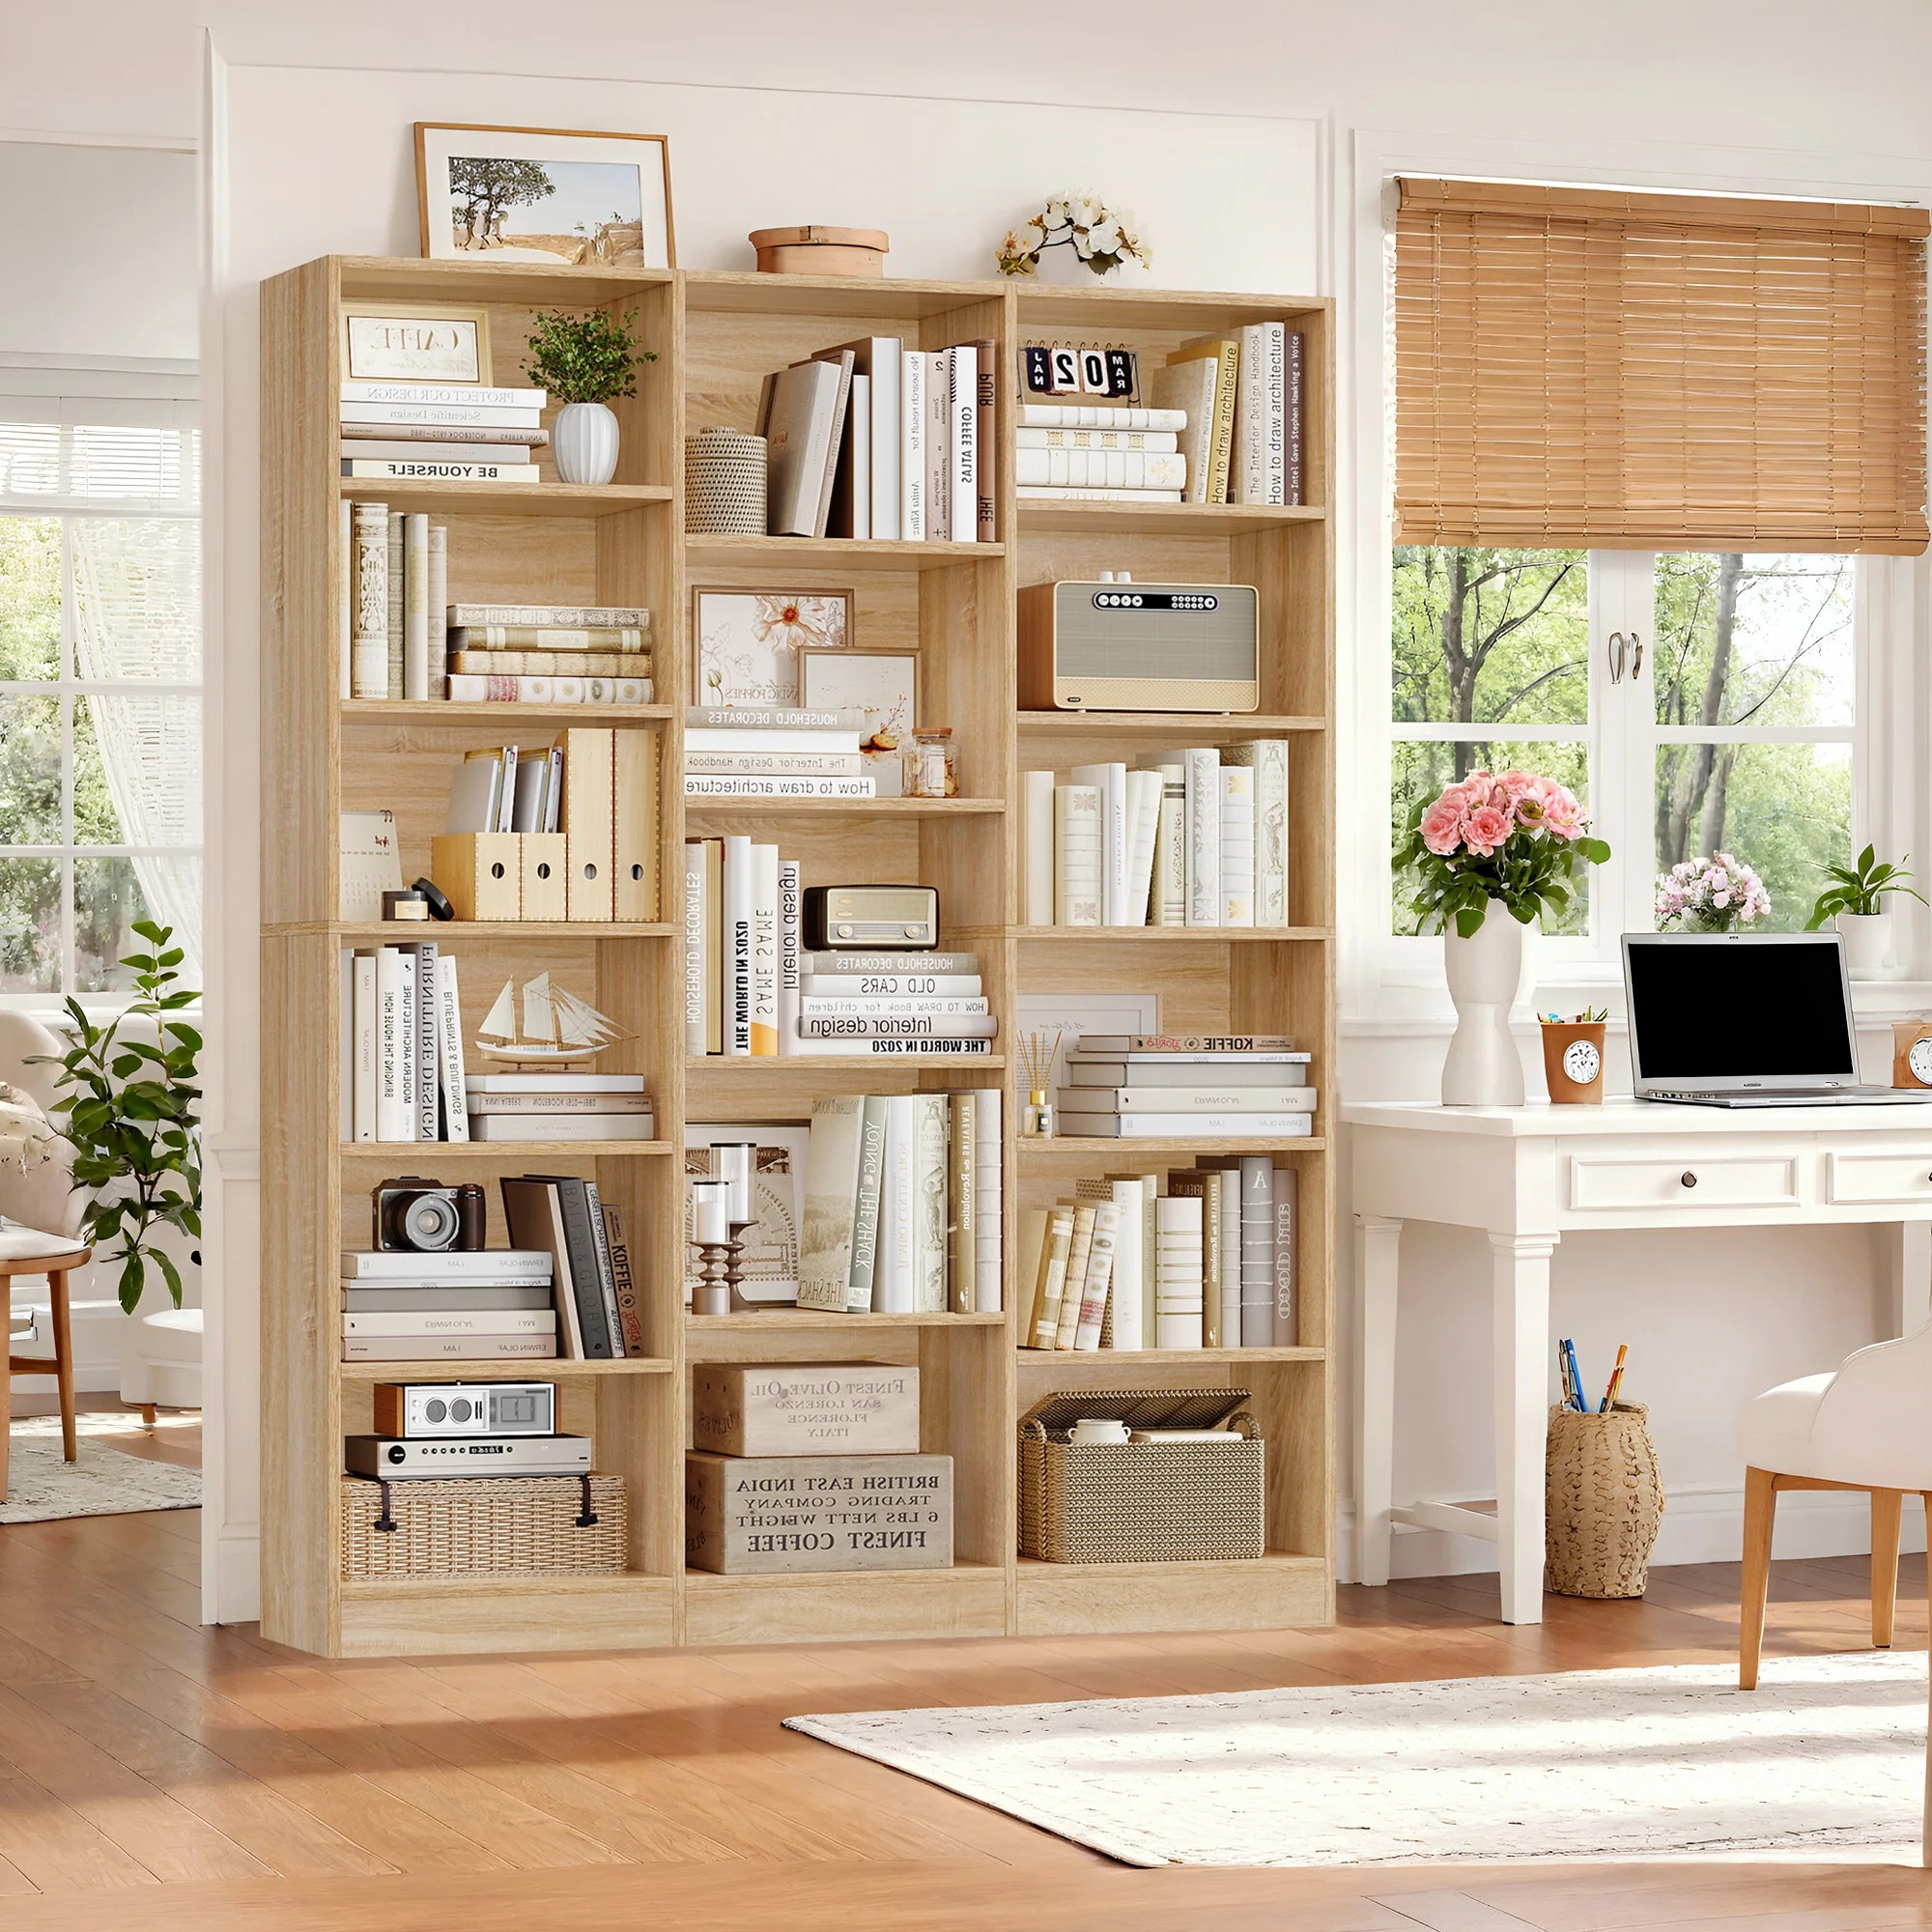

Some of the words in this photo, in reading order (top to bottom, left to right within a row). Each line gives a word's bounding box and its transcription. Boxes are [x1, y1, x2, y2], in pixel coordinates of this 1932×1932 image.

[1250, 332, 1261, 381] Handbook
[1291, 334, 1300, 359] Voice
[1219, 347, 1236, 423] architecture
[1268, 328, 1282, 413] architecture
[1250, 384, 1262, 420] Design
[1291, 371, 1301, 404] Hawking
[1268, 417, 1282, 452] draw
[1291, 407, 1301, 440] Stephen
[1215, 425, 1230, 457] draw
[1250, 425, 1261, 471] Interior
[1291, 442, 1300, 463] Gave
[1213, 461, 1227, 473] to
[1269, 456, 1282, 469] to
[1291, 466, 1300, 489] Intel
[1211, 475, 1226, 504] How
[1250, 476, 1261, 495] The
[1268, 473, 1282, 504] How
[611, 1244, 633, 1292] KOFFIE
[579, 1269, 602, 1333] GLORY
